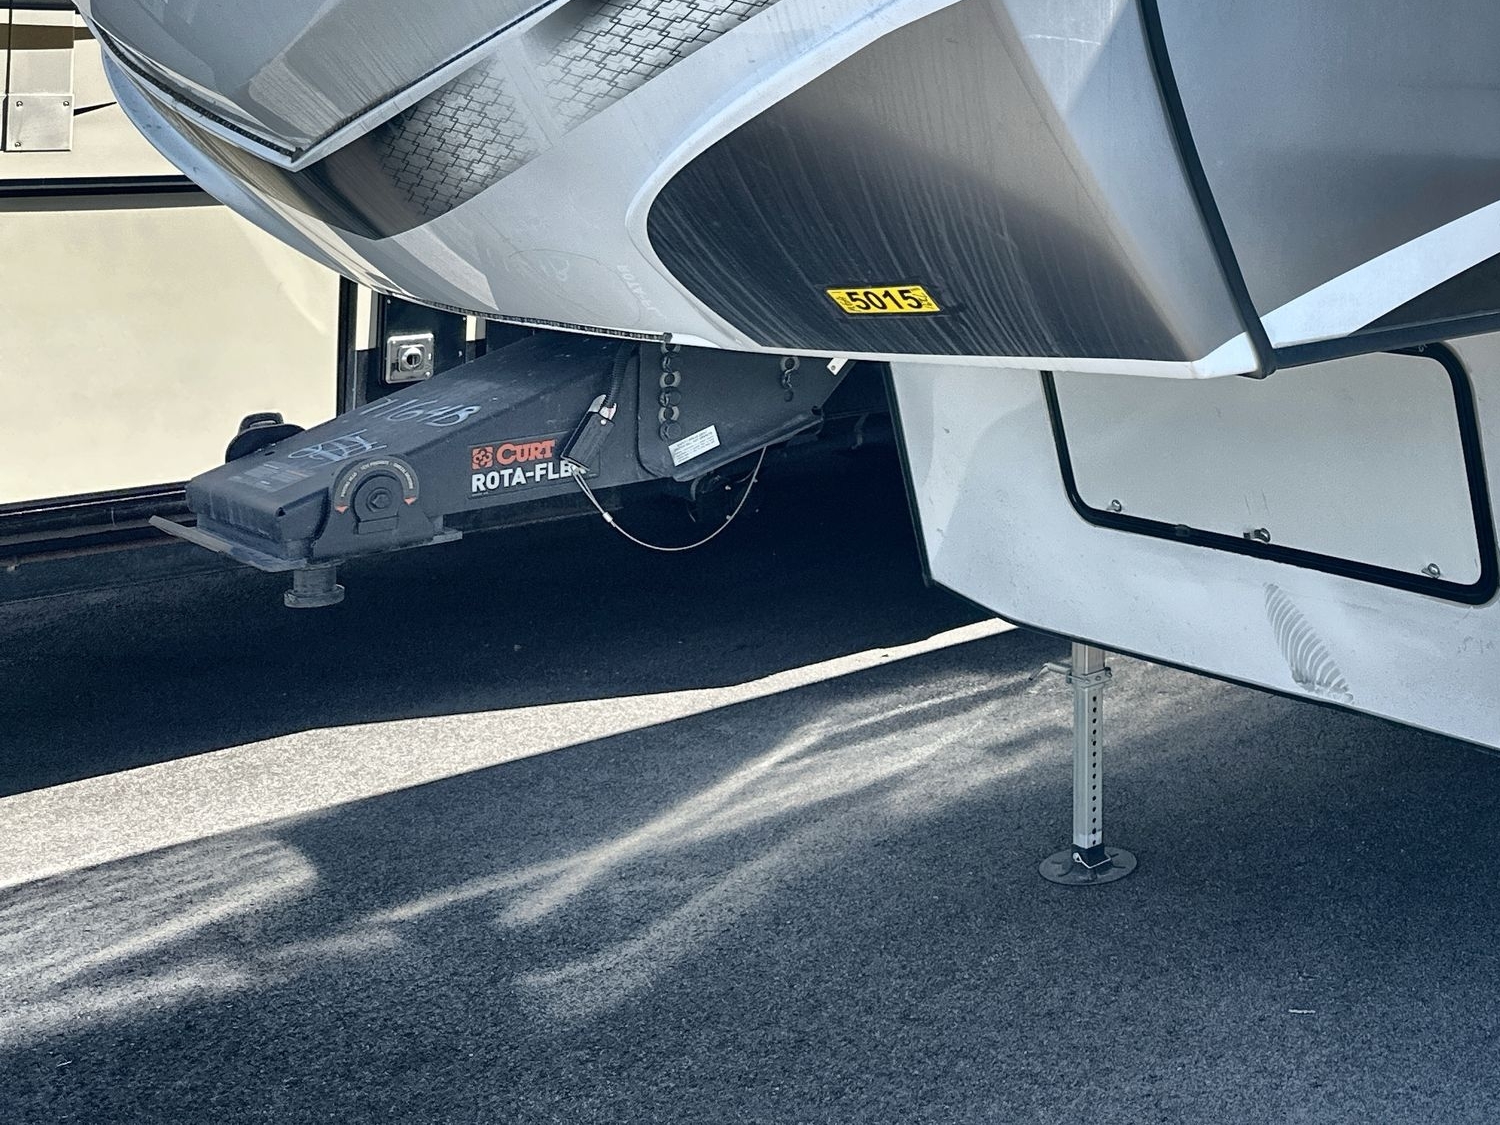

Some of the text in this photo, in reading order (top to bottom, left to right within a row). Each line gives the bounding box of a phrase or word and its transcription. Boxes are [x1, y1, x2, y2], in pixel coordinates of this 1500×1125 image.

[845, 289, 923, 310] 5015
[496, 439, 556, 465] CURT
[471, 459, 587, 493] ROTA-FLE
